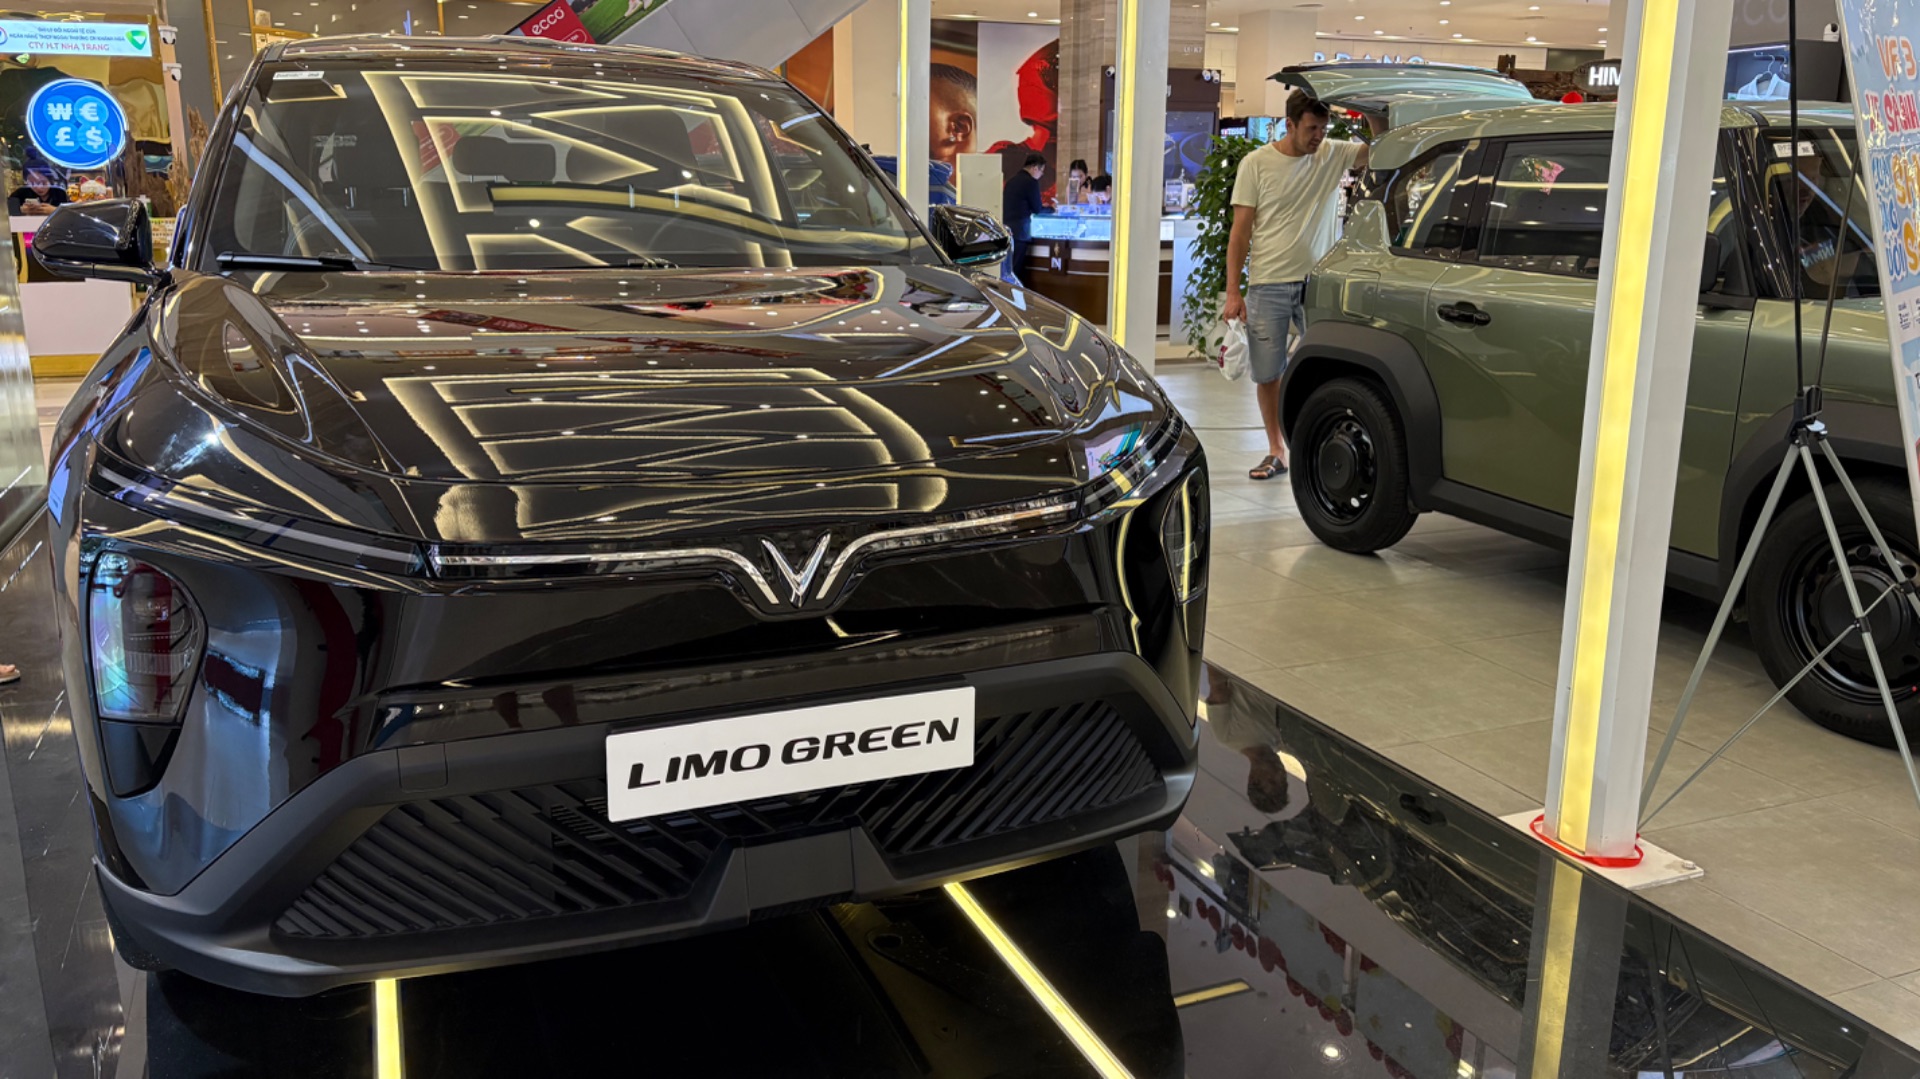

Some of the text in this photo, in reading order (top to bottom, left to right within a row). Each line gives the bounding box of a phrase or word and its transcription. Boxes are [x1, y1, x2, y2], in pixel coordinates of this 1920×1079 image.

[532, 8, 565, 35] ecco
[28, 41, 44, 49] CTY
[81, 43, 110, 51] TRANG
[1876, 35, 1916, 80] VF 3
[627, 717, 960, 789] LIMO GREEN
